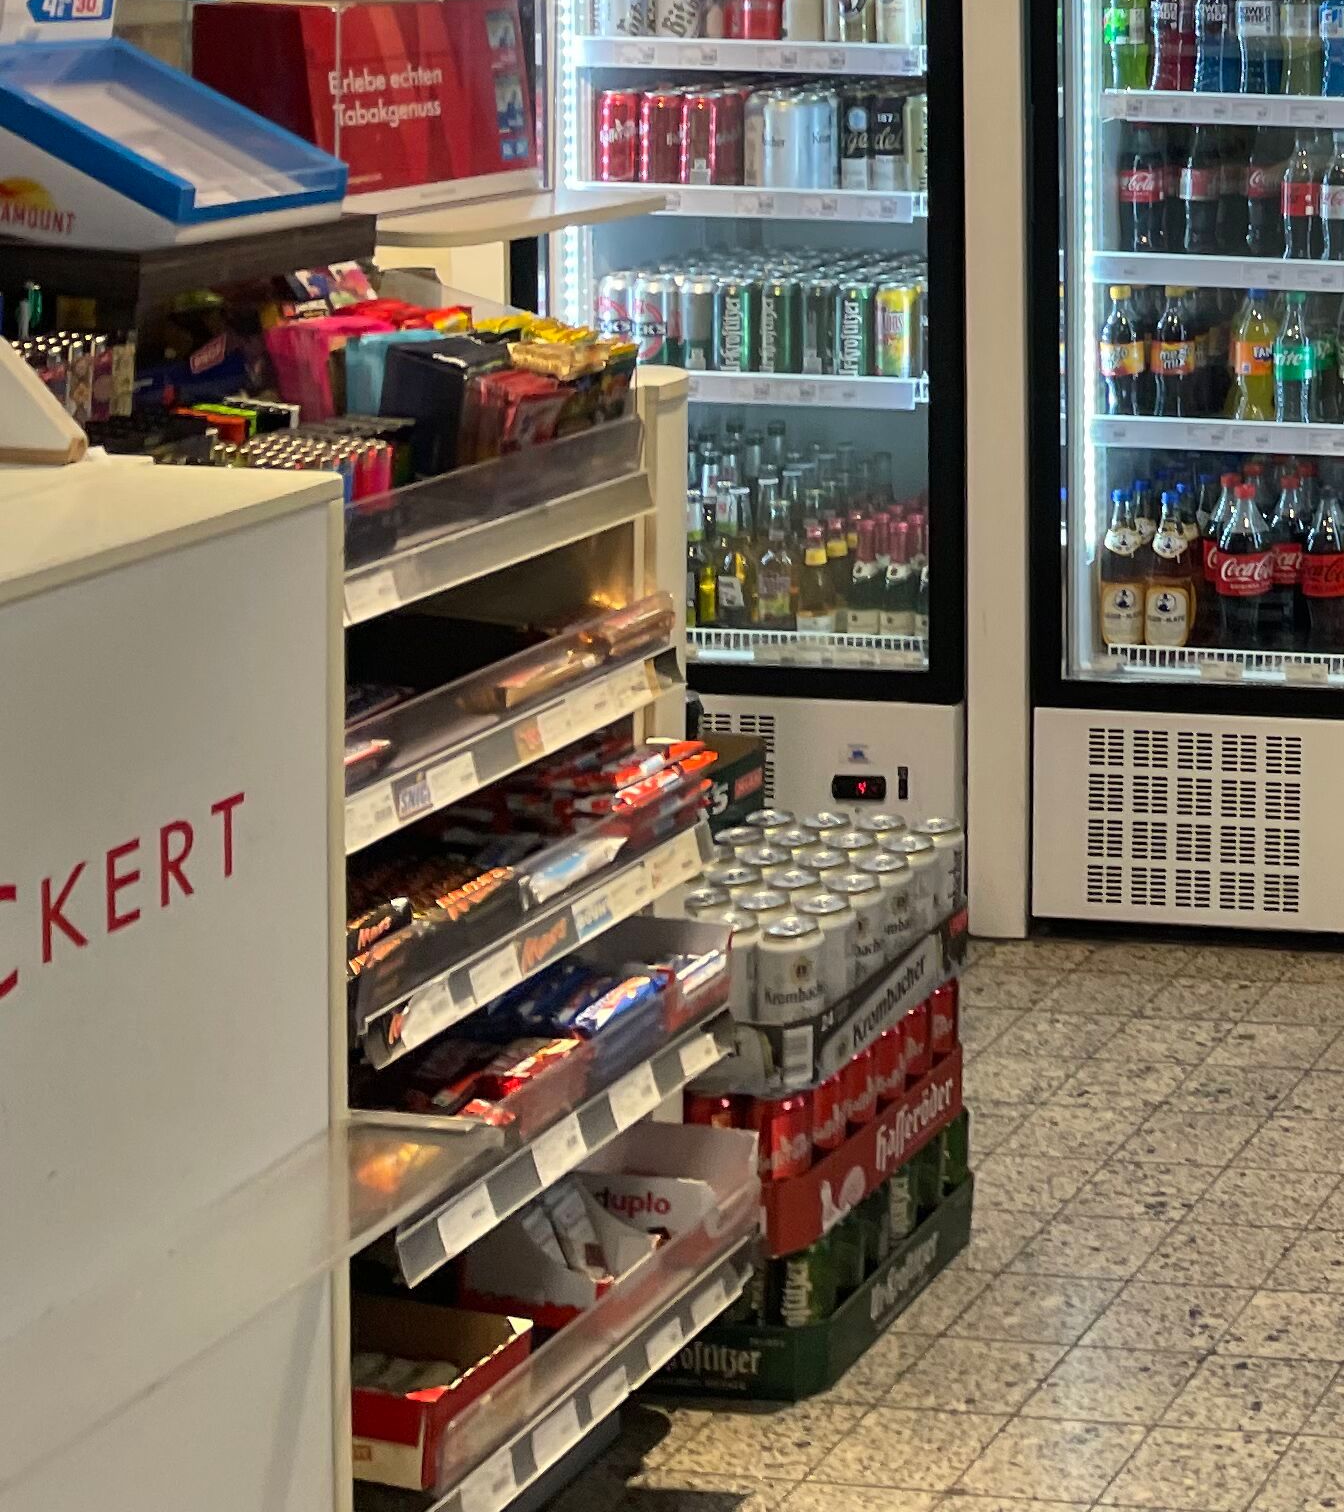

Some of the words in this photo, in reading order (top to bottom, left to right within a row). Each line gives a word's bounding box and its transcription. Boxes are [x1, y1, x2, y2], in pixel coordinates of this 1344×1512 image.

[327, 69, 385, 94] Erlebe
[389, 66, 443, 89] echten
[333, 97, 442, 128] Tabakgenuss
[0, 791, 247, 999] KERT
[853, 954, 927, 1044] Krombacher
